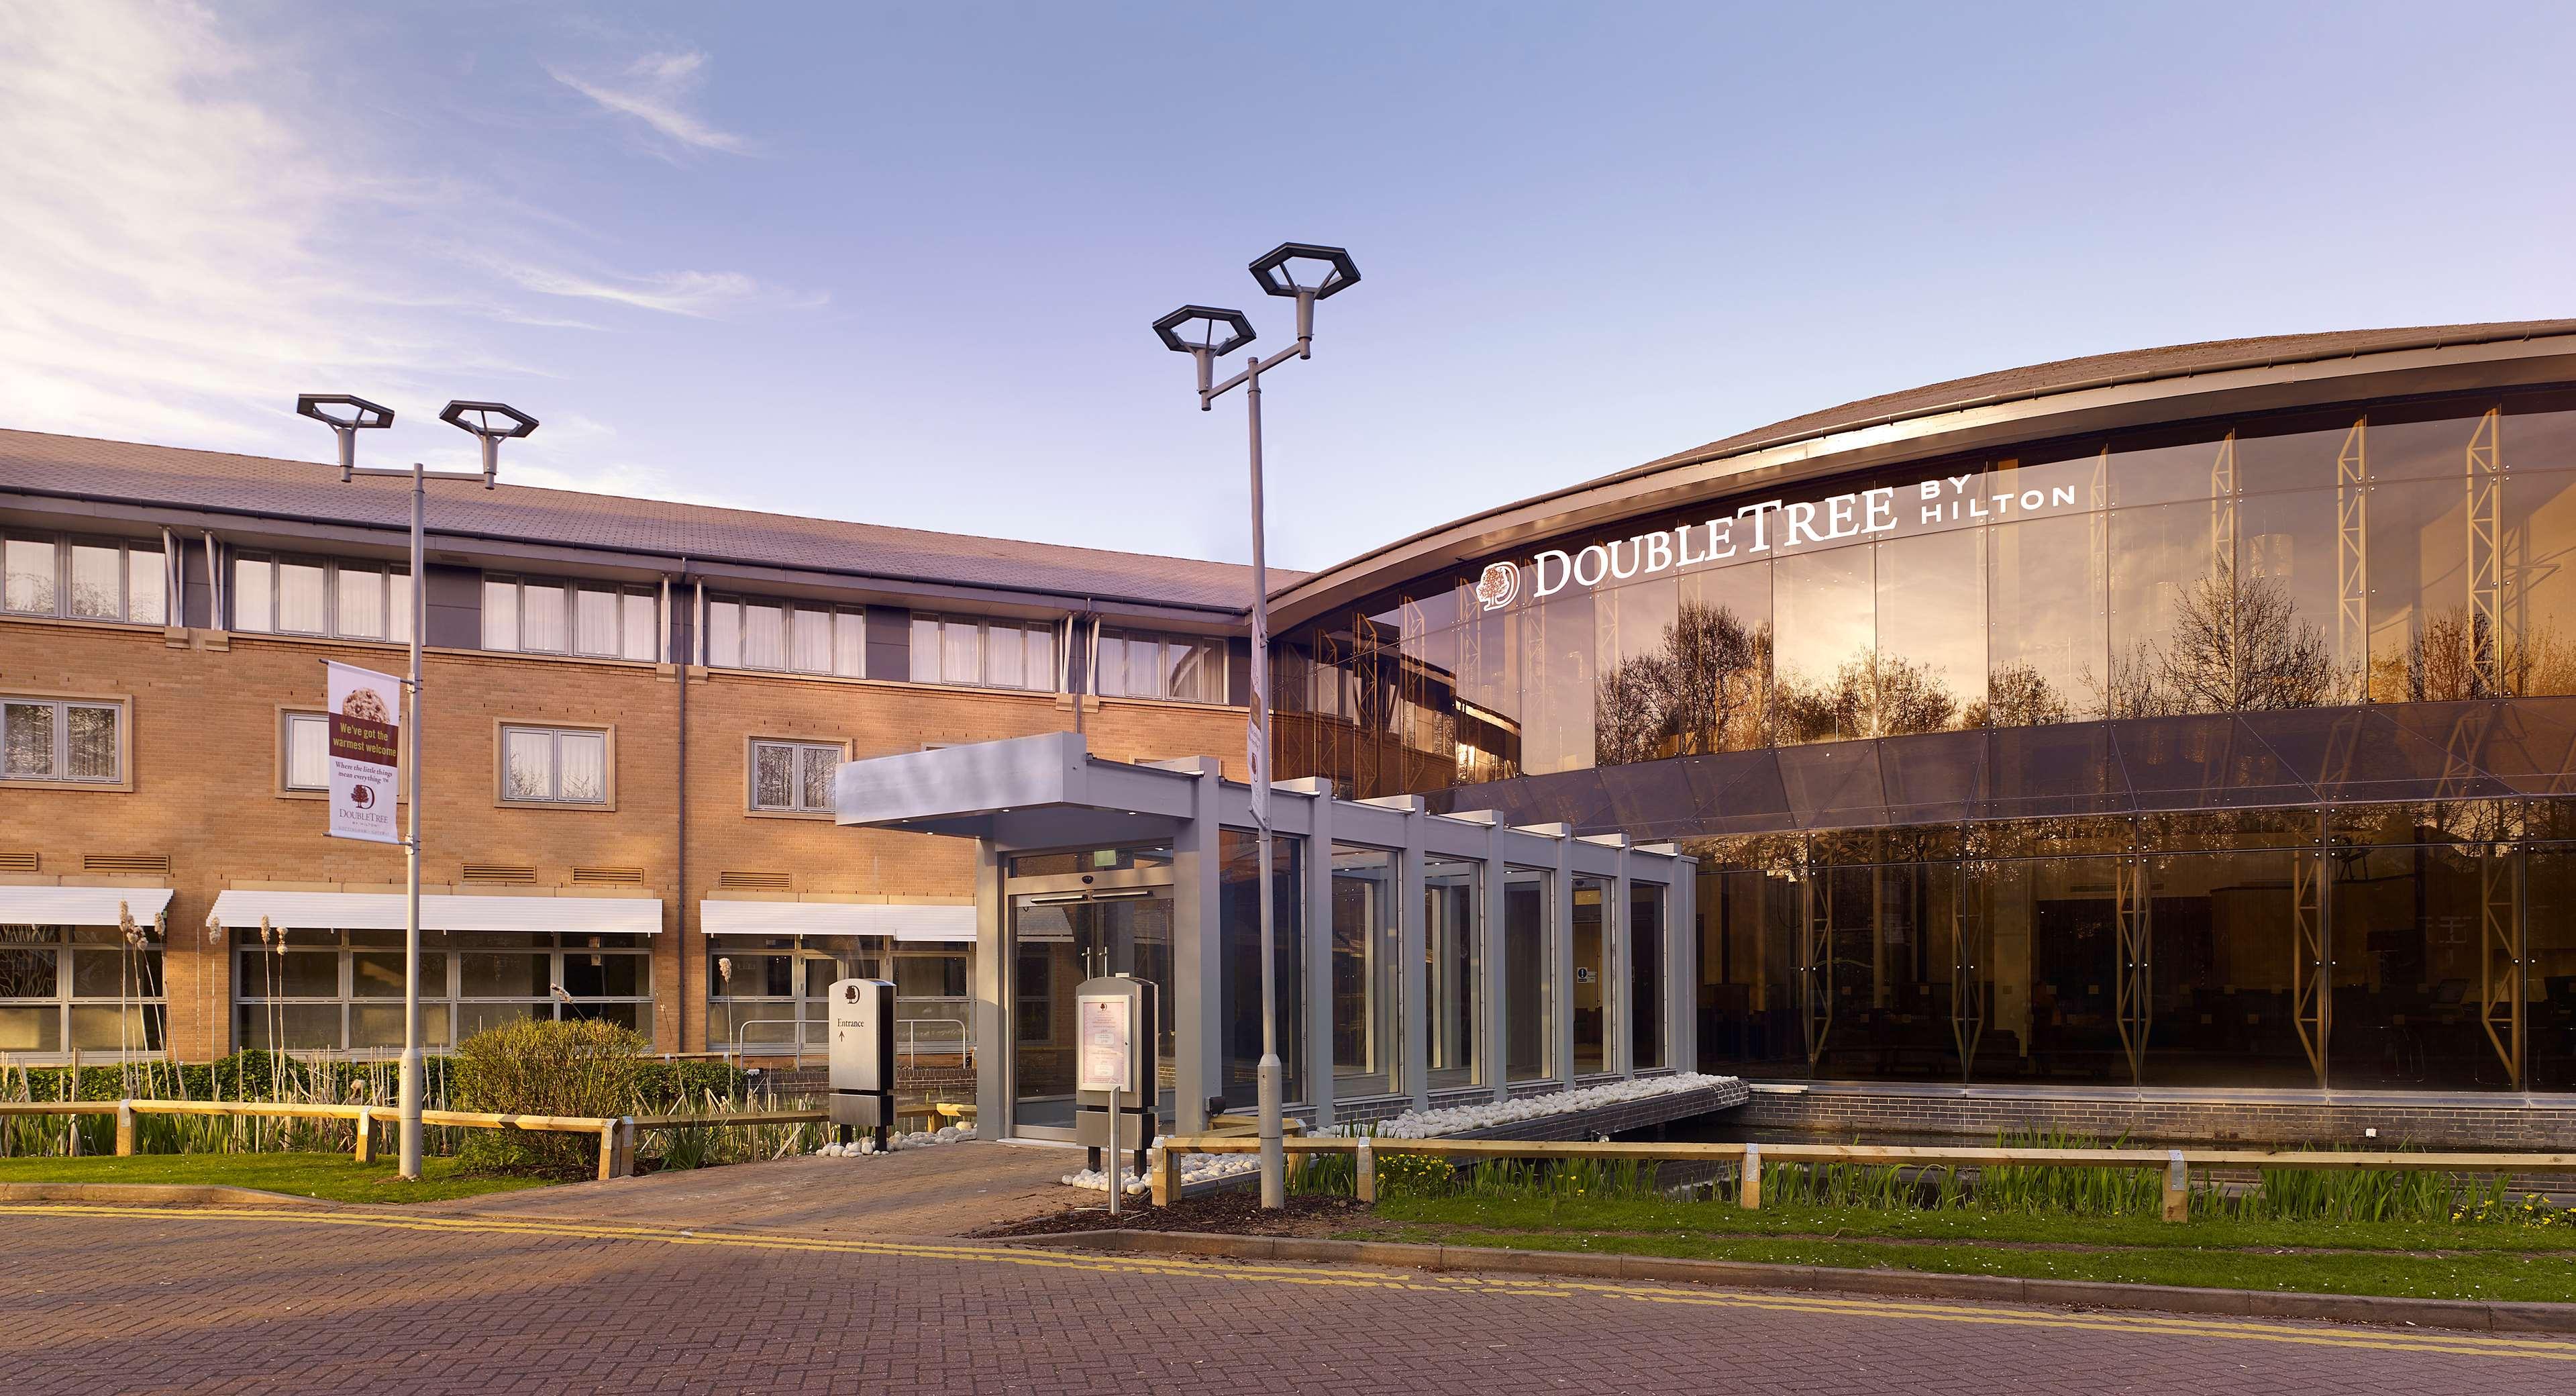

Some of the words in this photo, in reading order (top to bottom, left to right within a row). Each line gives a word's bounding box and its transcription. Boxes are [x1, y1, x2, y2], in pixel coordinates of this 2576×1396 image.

[1920, 473, 1971, 500] BY
[1921, 485, 2075, 524] HILTON
[340, 722, 362, 736] We've
[364, 730, 376, 740] got
[378, 730, 389, 741] the
[333, 738, 364, 751] warmest
[366, 744, 397, 756] welcome
[336, 761, 352, 770] Where
[363, 766, 376, 774] little
[376, 768, 393, 778] things
[354, 775, 382, 785] everything
[837, 1018, 864, 1028] Entrance
